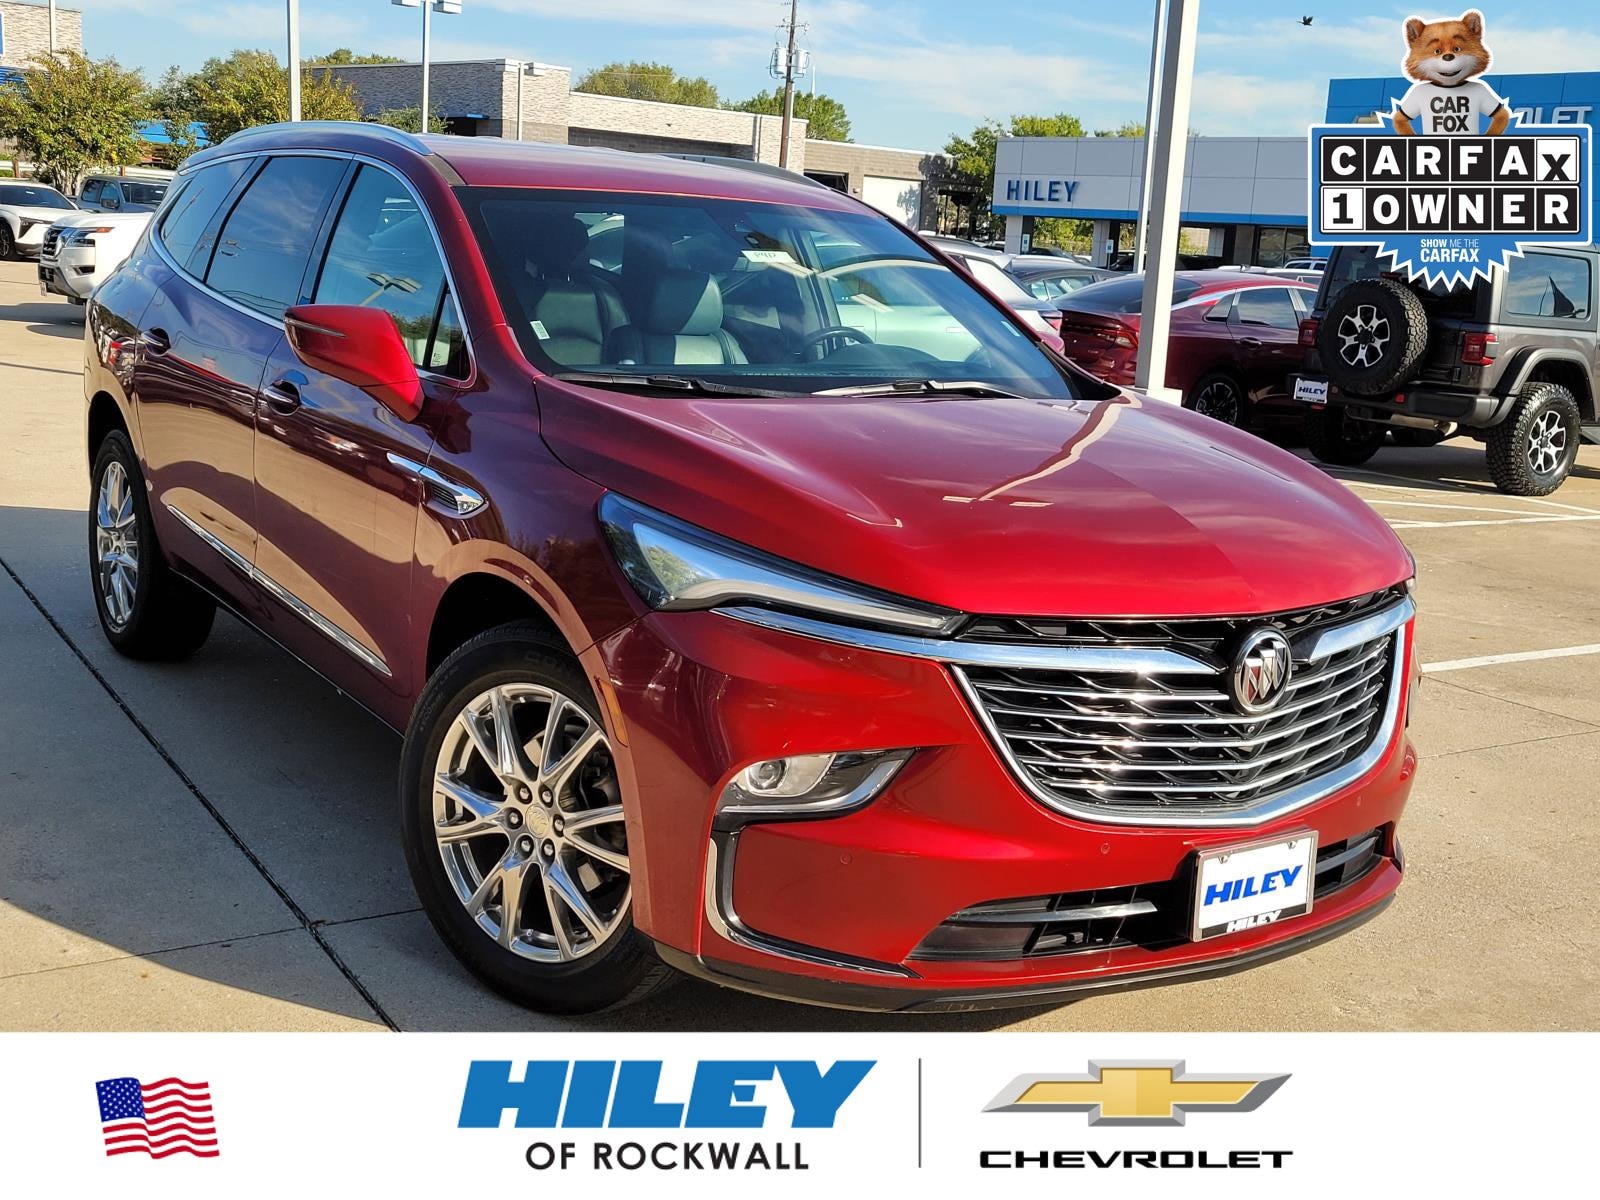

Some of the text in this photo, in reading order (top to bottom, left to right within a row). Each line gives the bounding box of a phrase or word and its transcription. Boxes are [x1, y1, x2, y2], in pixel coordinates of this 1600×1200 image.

[1006, 179, 1079, 202] HILEY
[1298, 386, 1326, 395] HILEY
[1203, 864, 1304, 907] HILEY
[1226, 909, 1282, 934] HILEY
